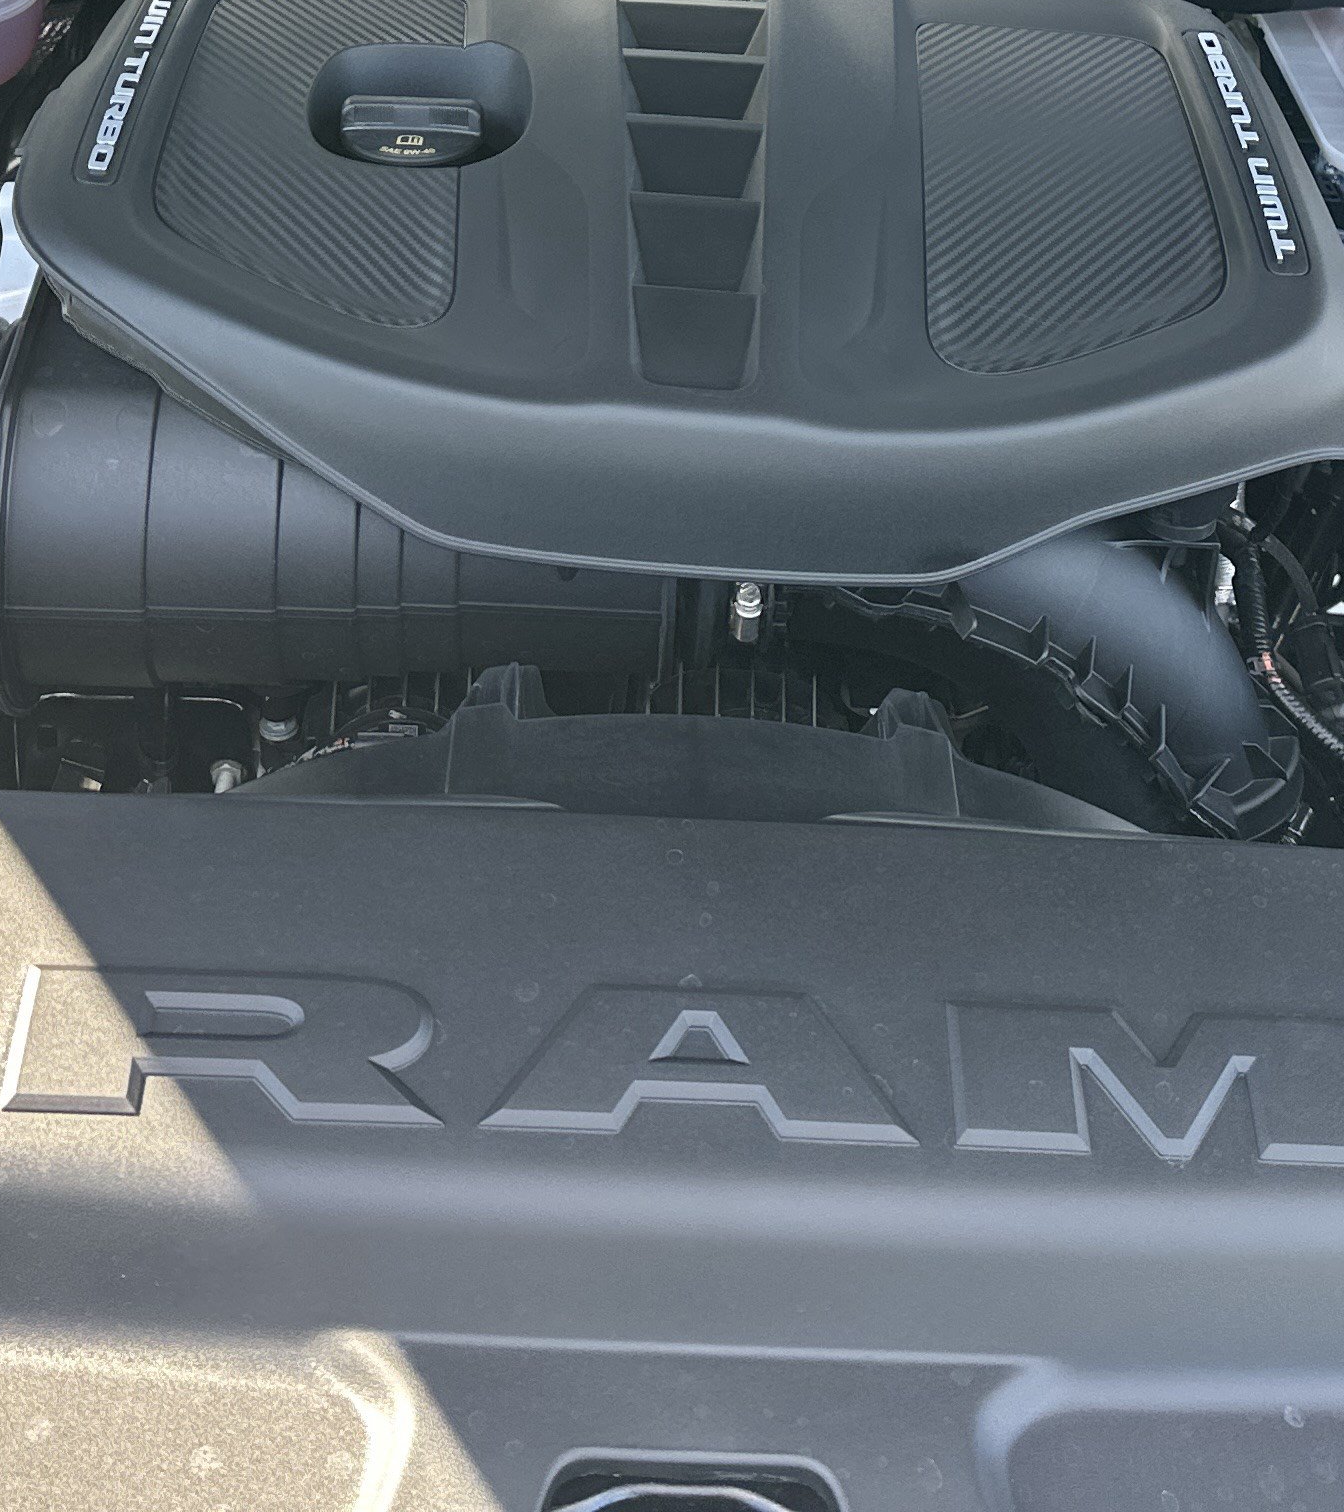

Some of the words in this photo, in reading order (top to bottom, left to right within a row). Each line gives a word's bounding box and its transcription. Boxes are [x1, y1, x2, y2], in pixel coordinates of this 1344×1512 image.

[87, 50, 150, 171] TURBO
[1197, 31, 1260, 150] TURBO
[378, 145, 403, 155] SAE
[1247, 156, 1296, 264] TWIN
